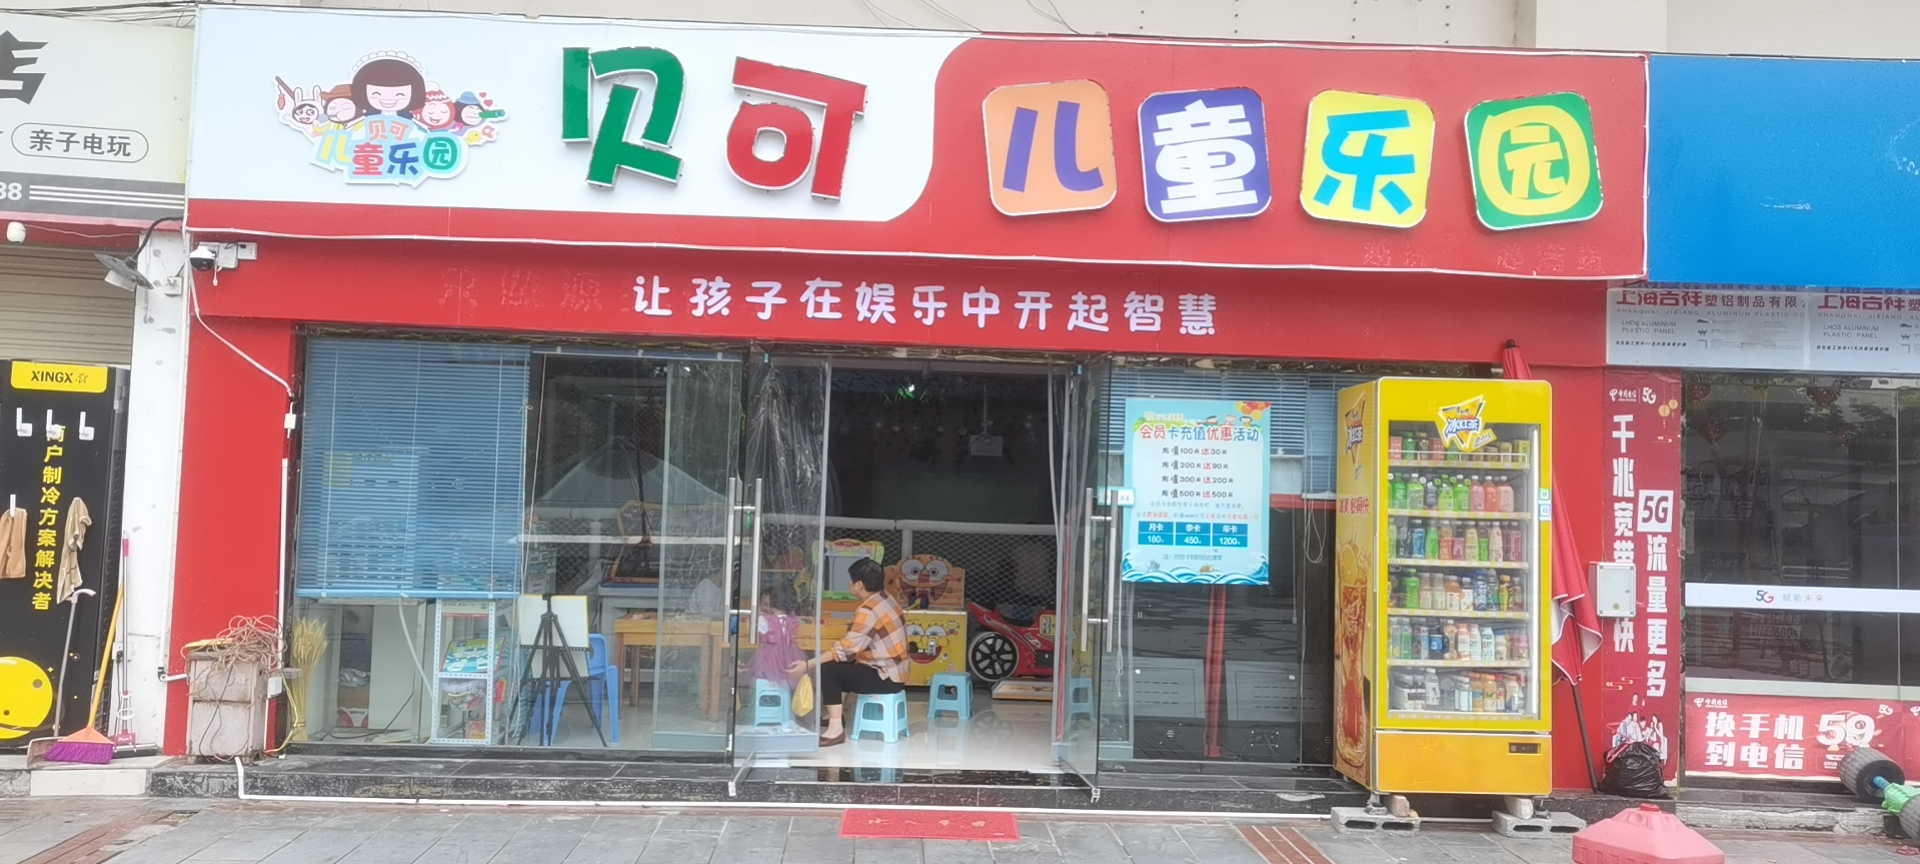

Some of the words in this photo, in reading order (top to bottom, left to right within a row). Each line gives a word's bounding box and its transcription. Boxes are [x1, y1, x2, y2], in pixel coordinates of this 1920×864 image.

[29, 129, 132, 157] 亲子电玩
[368, 119, 409, 142] 贝可
[561, 46, 868, 202] 贝可
[1001, 98, 1592, 217] 儿童乐园
[319, 136, 458, 177] 儿童乐园
[632, 275, 1217, 337] 让孩子在娱乐中开起智慧
[1642, 387, 1657, 404] 5G
[1139, 424, 1259, 442] 会员卡充值优惠活动
[1148, 522, 1164, 532] 月卡
[1222, 525, 1238, 534] 年卡
[1611, 414, 1635, 653] 千兆宽带快
[1755, 589, 1775, 604] 5G
[1782, 593, 1825, 604] 赋能未来
[1878, 704, 1894, 715] 5G
[1705, 711, 1804, 741] 换手机
[1816, 714, 1875, 748] 59
[1704, 741, 1806, 770] 到电信
